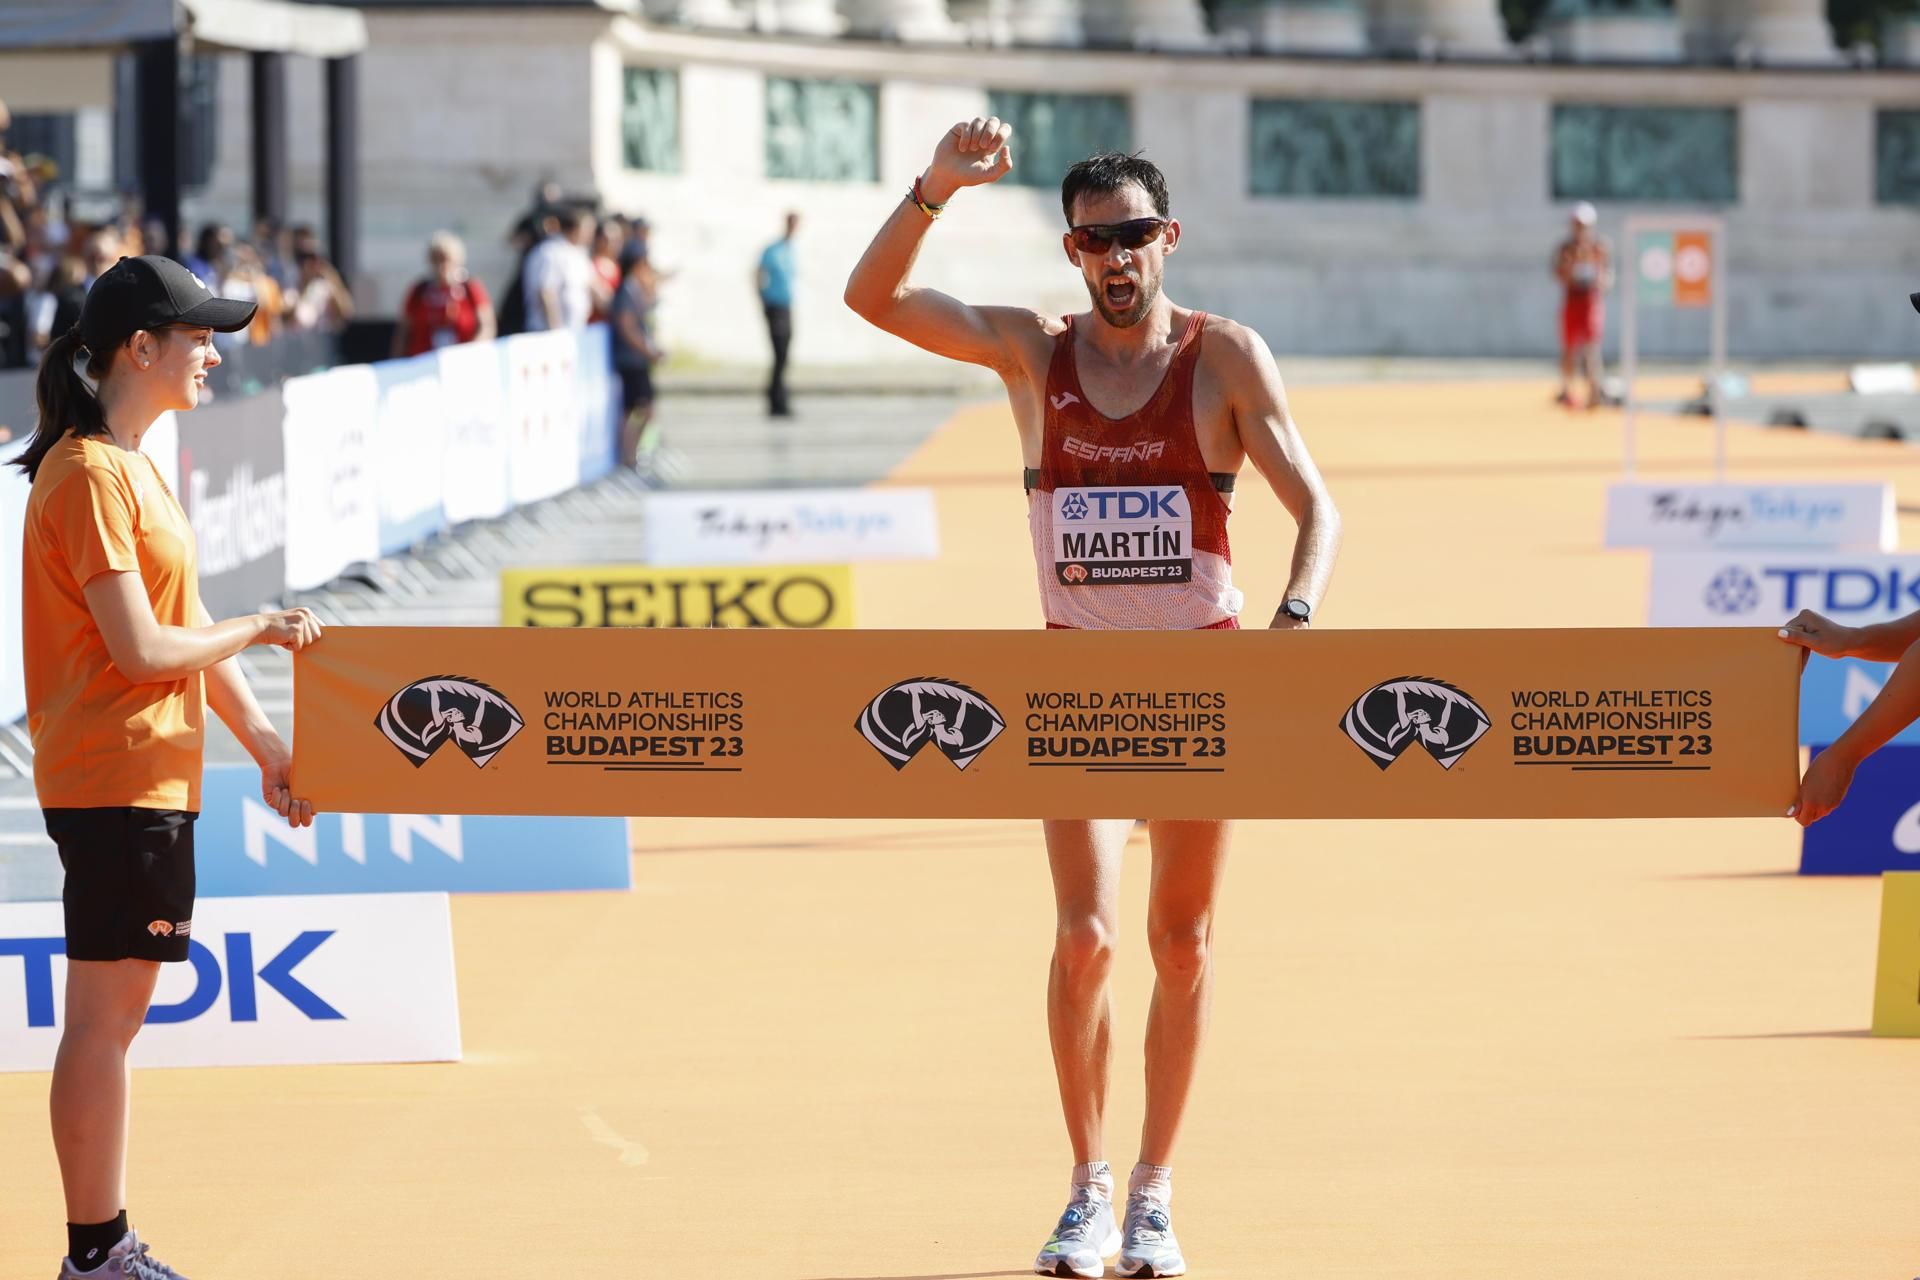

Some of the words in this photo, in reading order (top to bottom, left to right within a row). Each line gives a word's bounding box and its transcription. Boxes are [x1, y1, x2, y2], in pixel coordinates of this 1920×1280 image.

[1062, 436, 1166, 463] ESPAÑA
[1088, 491, 1181, 519] TDK
[1062, 525, 1181, 559] MARTÍN
[1092, 567, 1166, 578] BUDAPEST
[1167, 565, 1183, 577] 23
[1763, 566, 1920, 612] TDK
[522, 576, 835, 628] SEIKO
[544, 691, 622, 708] WORLD
[627, 691, 743, 709] ATHLETICS
[1025, 692, 1104, 709] WORLD
[1109, 692, 1226, 709] ATHLETICS
[1511, 690, 1590, 708] WORLD
[1595, 690, 1712, 708] ATHLETICS
[544, 712, 743, 731] CHAMPIONSHIPS
[1025, 713, 1226, 732] CHAMPIONSHIPS
[1511, 711, 1712, 731] CHAMPIONSHIPS
[546, 735, 705, 756] BUDAPEST
[710, 736, 744, 757] 23
[1028, 737, 1187, 757] BUDAPEST
[1192, 737, 1226, 758] 23
[1513, 735, 1673, 756] BUDAPEST
[1678, 734, 1713, 756] 23
